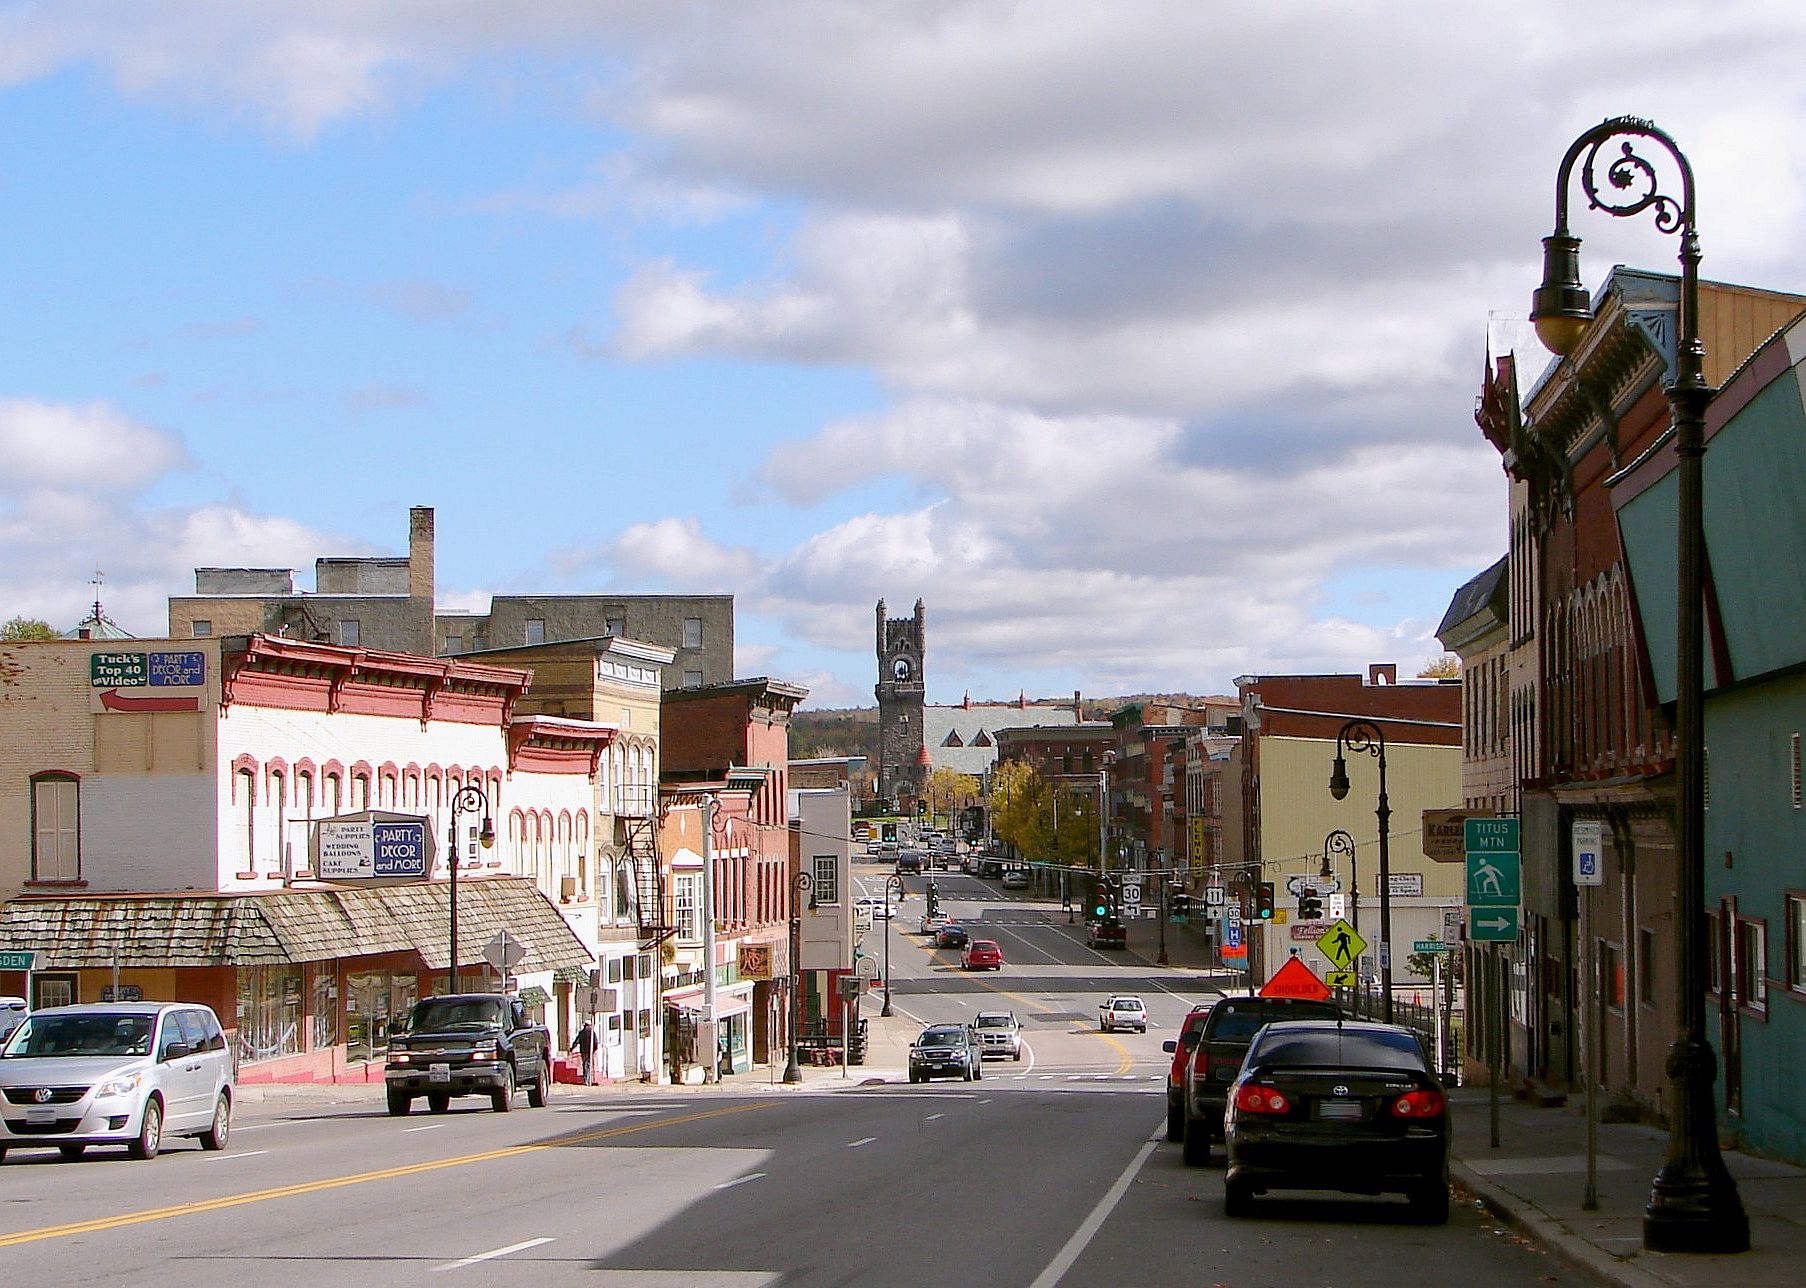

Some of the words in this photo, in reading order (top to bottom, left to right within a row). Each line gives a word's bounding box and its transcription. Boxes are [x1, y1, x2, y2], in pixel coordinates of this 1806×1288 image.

[99, 655, 140, 664] Tuck's
[164, 655, 188, 665] PARTY
[97, 666, 121, 676] Top
[125, 666, 141, 675] 40
[152, 665, 180, 675] DECOR
[183, 665, 200, 674] and
[102, 676, 138, 686] Video
[163, 675, 190, 685] MORE
[1476, 823, 1508, 834] TITUS
[382, 829, 413, 842] PARTY
[1480, 837, 1505, 847] MTN
[381, 845, 416, 858] DECOR
[376, 859, 393, 870] and
[393, 859, 422, 870] MORE
[1124, 888, 1139, 899] 30
[1211, 891, 1220, 901] 11
[1230, 929, 1238, 940] H
